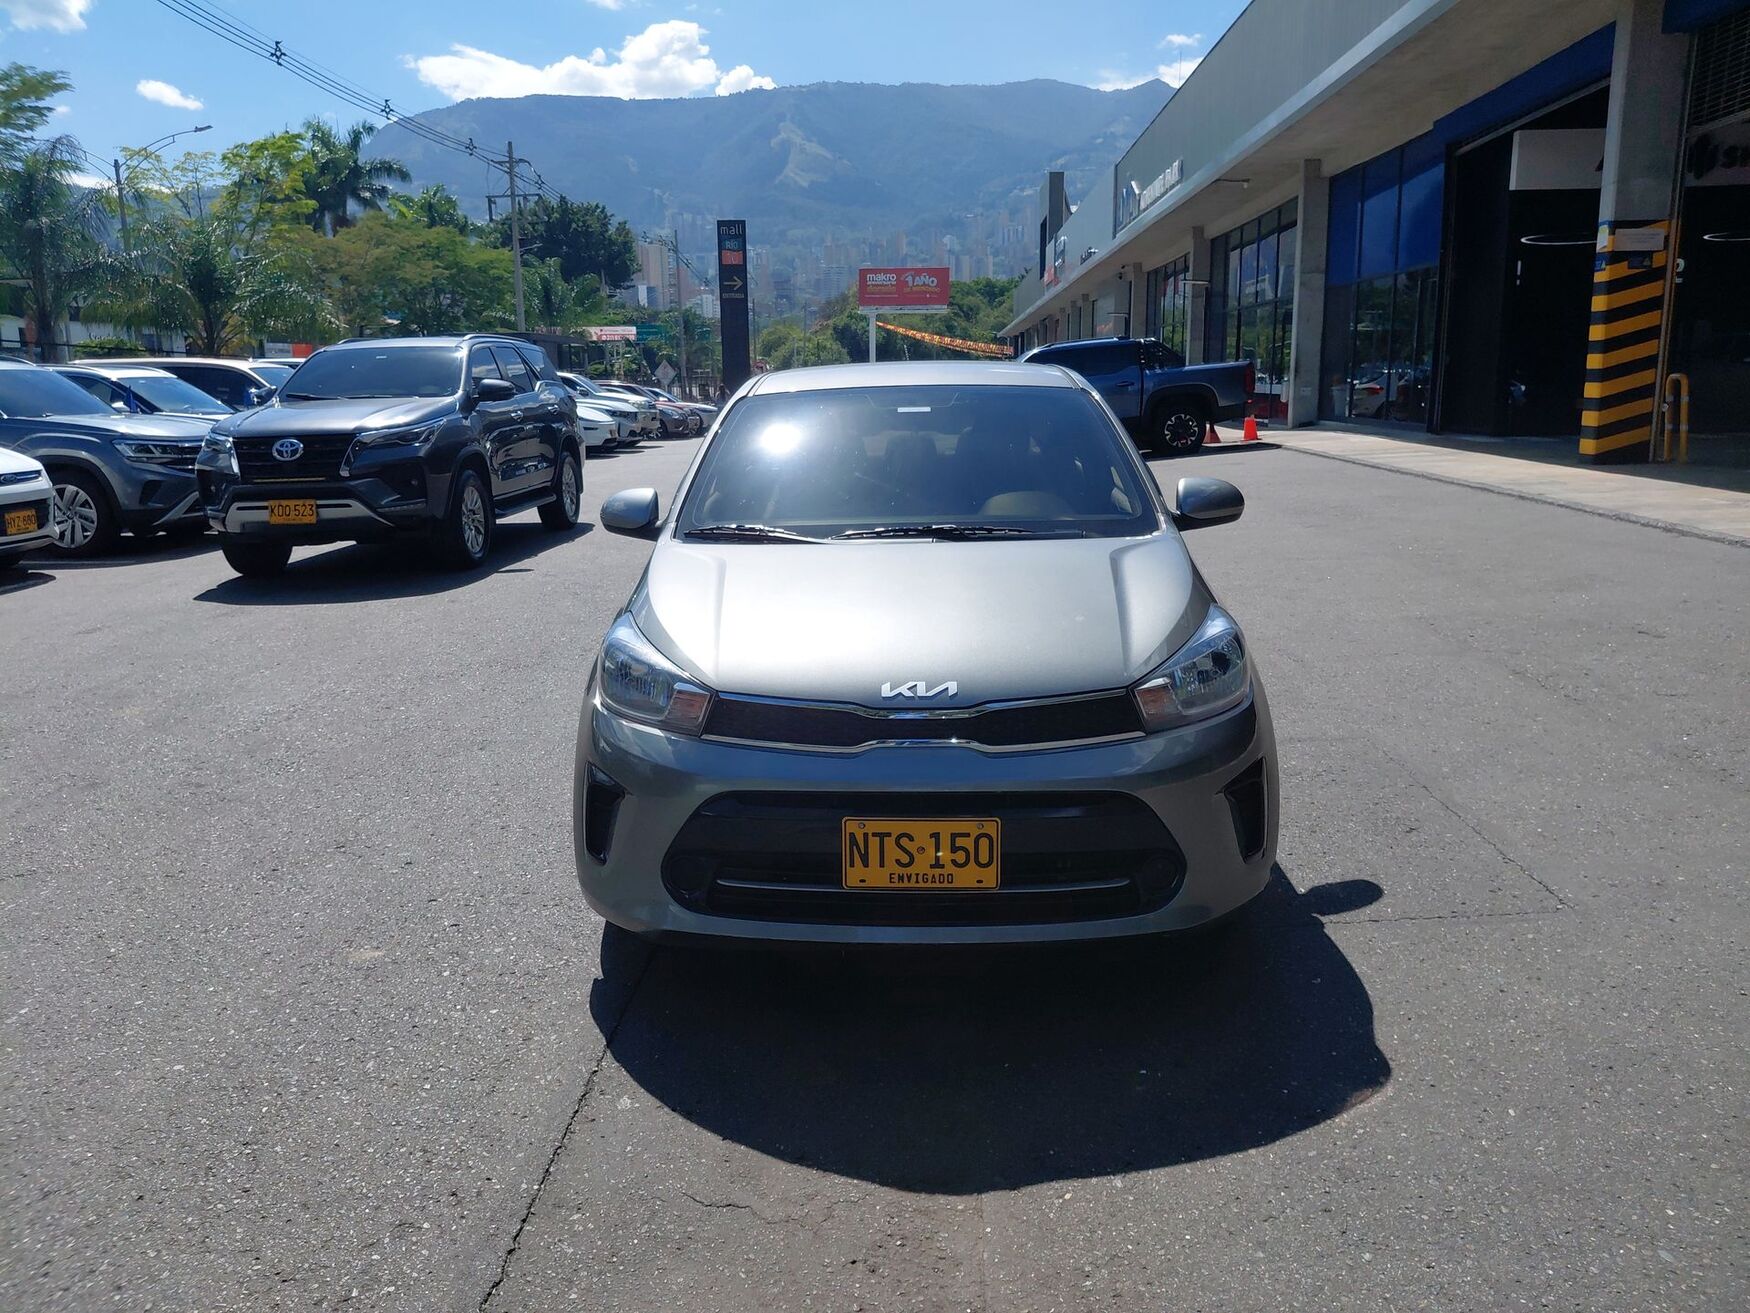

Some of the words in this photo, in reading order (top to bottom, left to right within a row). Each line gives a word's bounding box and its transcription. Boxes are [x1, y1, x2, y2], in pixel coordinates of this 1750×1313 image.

[720, 224, 743, 236] mall
[866, 272, 897, 282] makro
[914, 273, 938, 287] AÑO
[881, 681, 958, 698] KIA
[848, 831, 915, 869] NTS
[929, 831, 995, 869] 150
[888, 872, 955, 885] ENVIGADO
